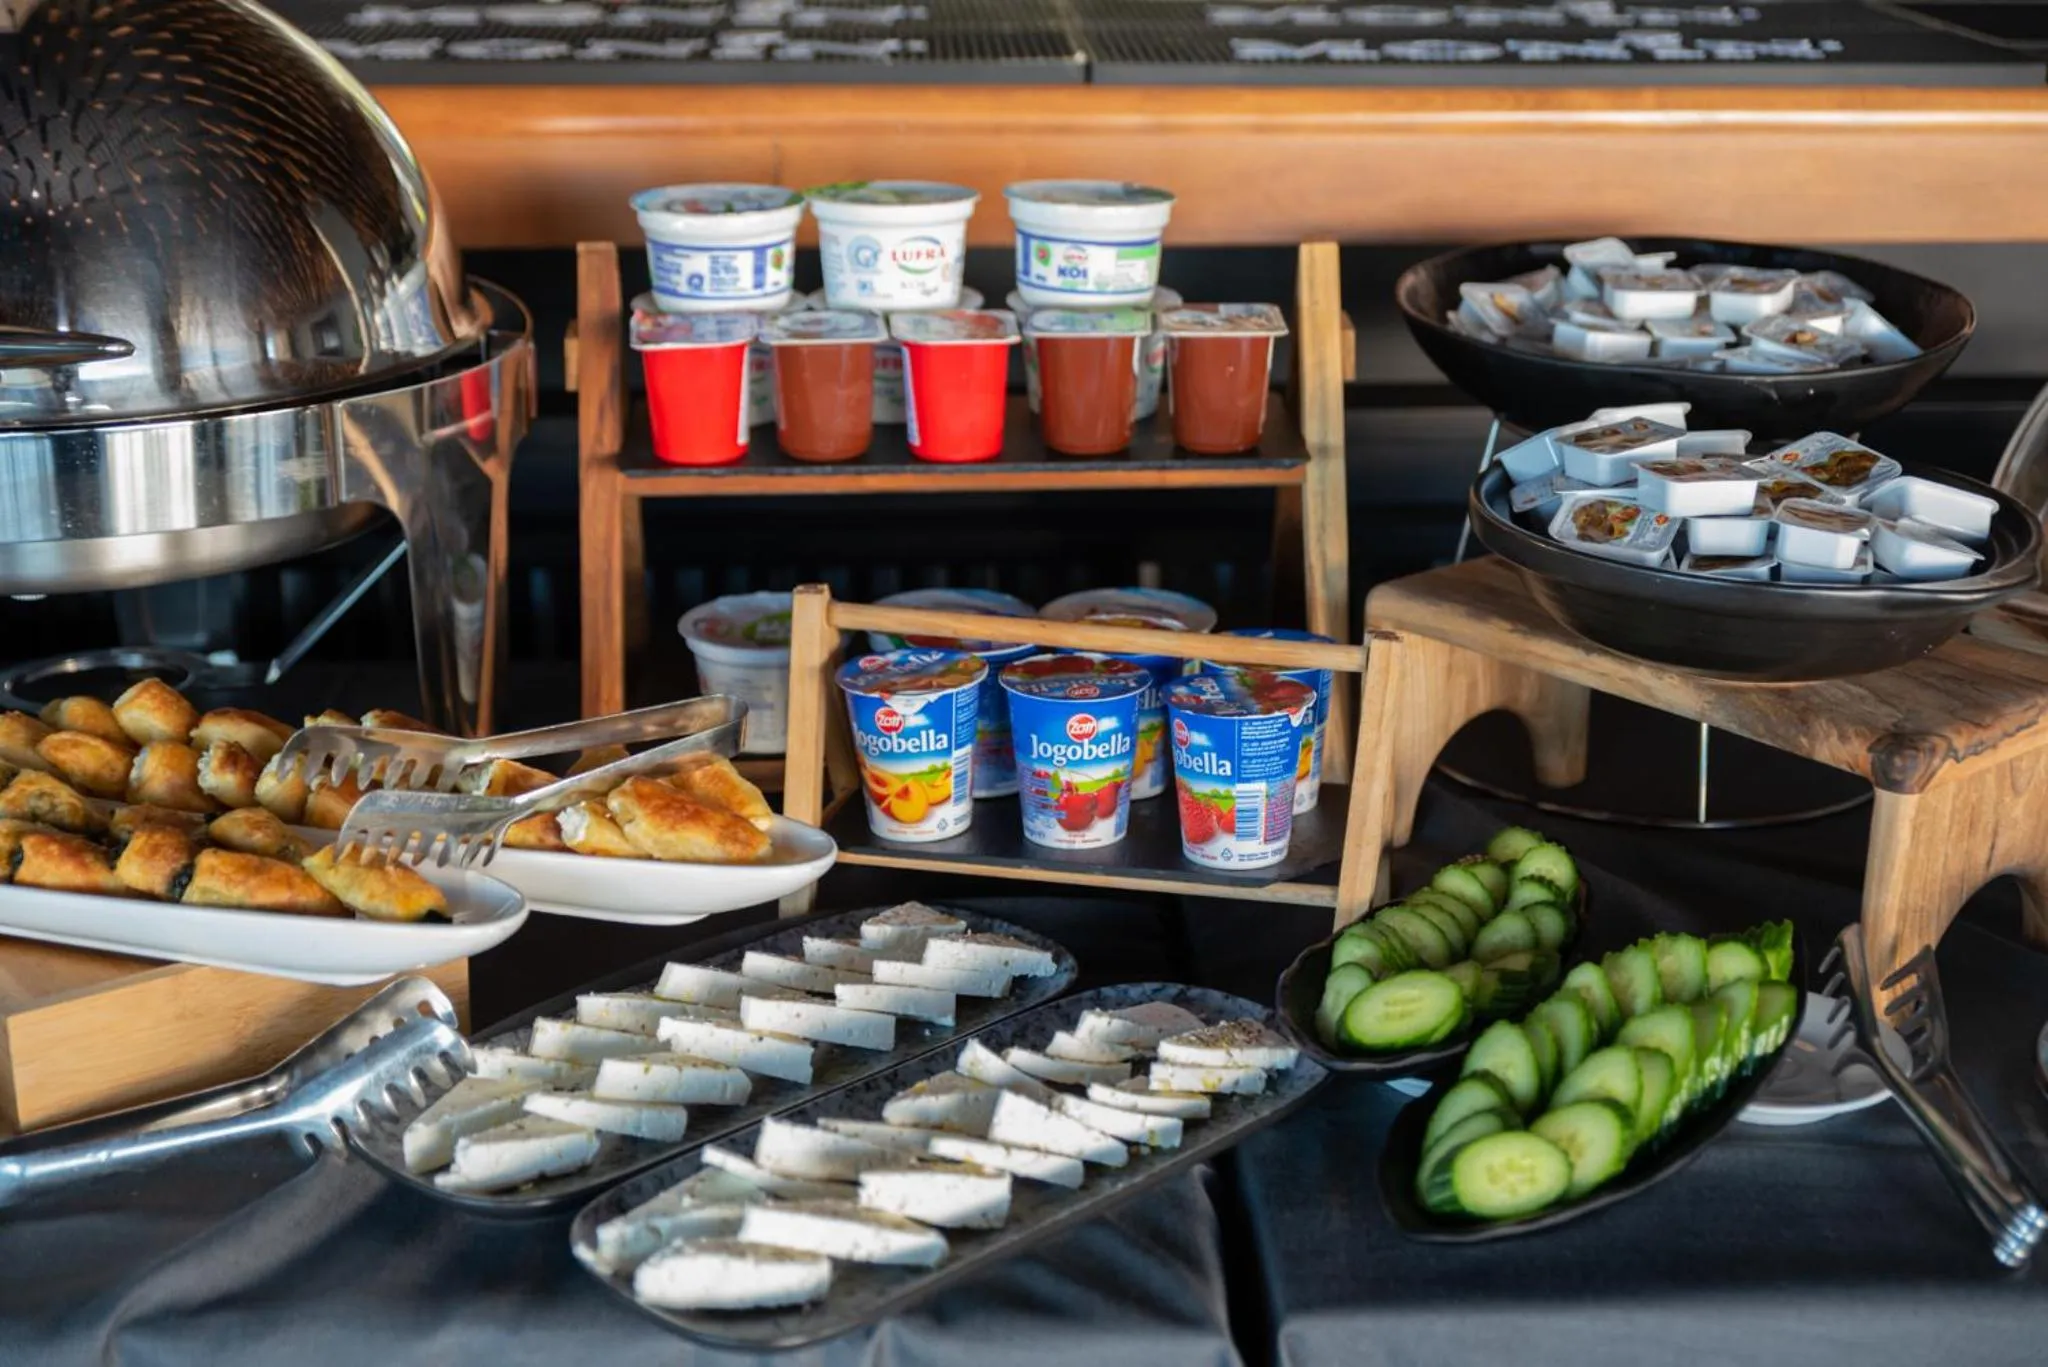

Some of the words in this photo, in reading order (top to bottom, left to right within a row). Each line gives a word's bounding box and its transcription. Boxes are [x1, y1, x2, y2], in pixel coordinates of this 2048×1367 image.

[1069, 720, 1096, 735] Zott
[1030, 733, 1131, 767] Jogobella
[1173, 747, 1232, 776] obella
